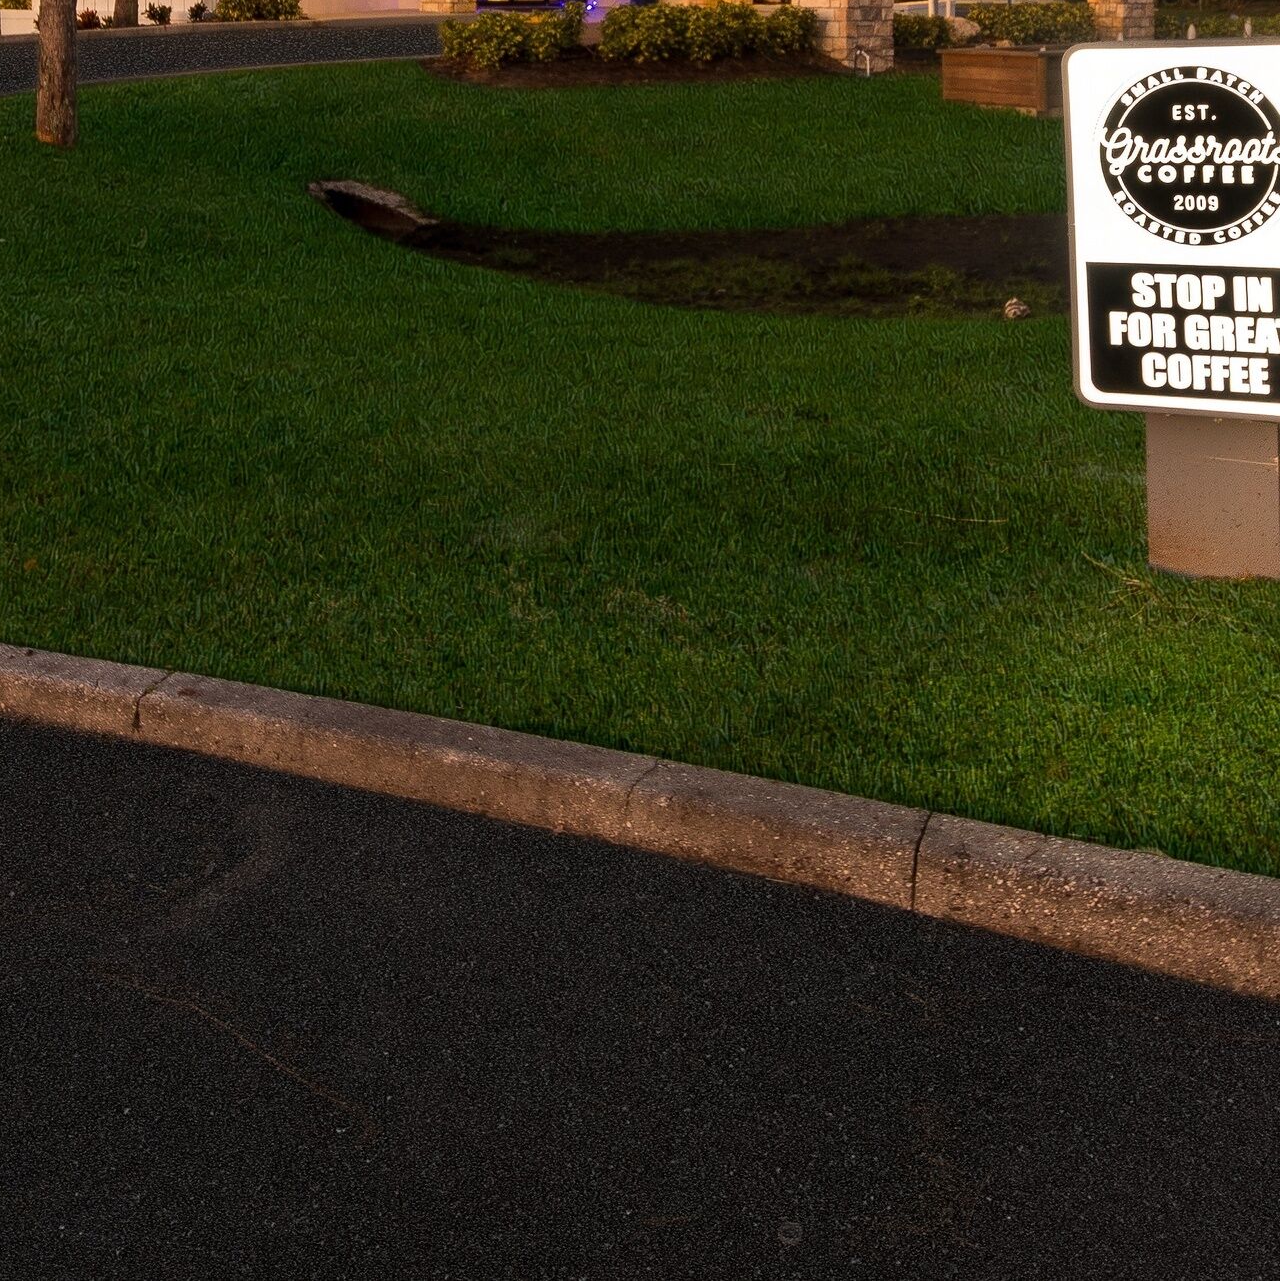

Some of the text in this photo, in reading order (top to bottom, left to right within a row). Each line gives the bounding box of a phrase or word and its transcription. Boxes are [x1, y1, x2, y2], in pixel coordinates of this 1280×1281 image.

[1120, 65, 1264, 108] SMALL BATCH
[1171, 104, 1218, 122] EST.
[1136, 164, 1256, 185] COFFEE
[1113, 190, 1202, 246] ROASTED
[1172, 194, 1220, 213] 2009
[1130, 273, 1274, 314] STOP IN
[1108, 310, 1178, 350] FOR
[1141, 351, 1272, 396] COFFEE
